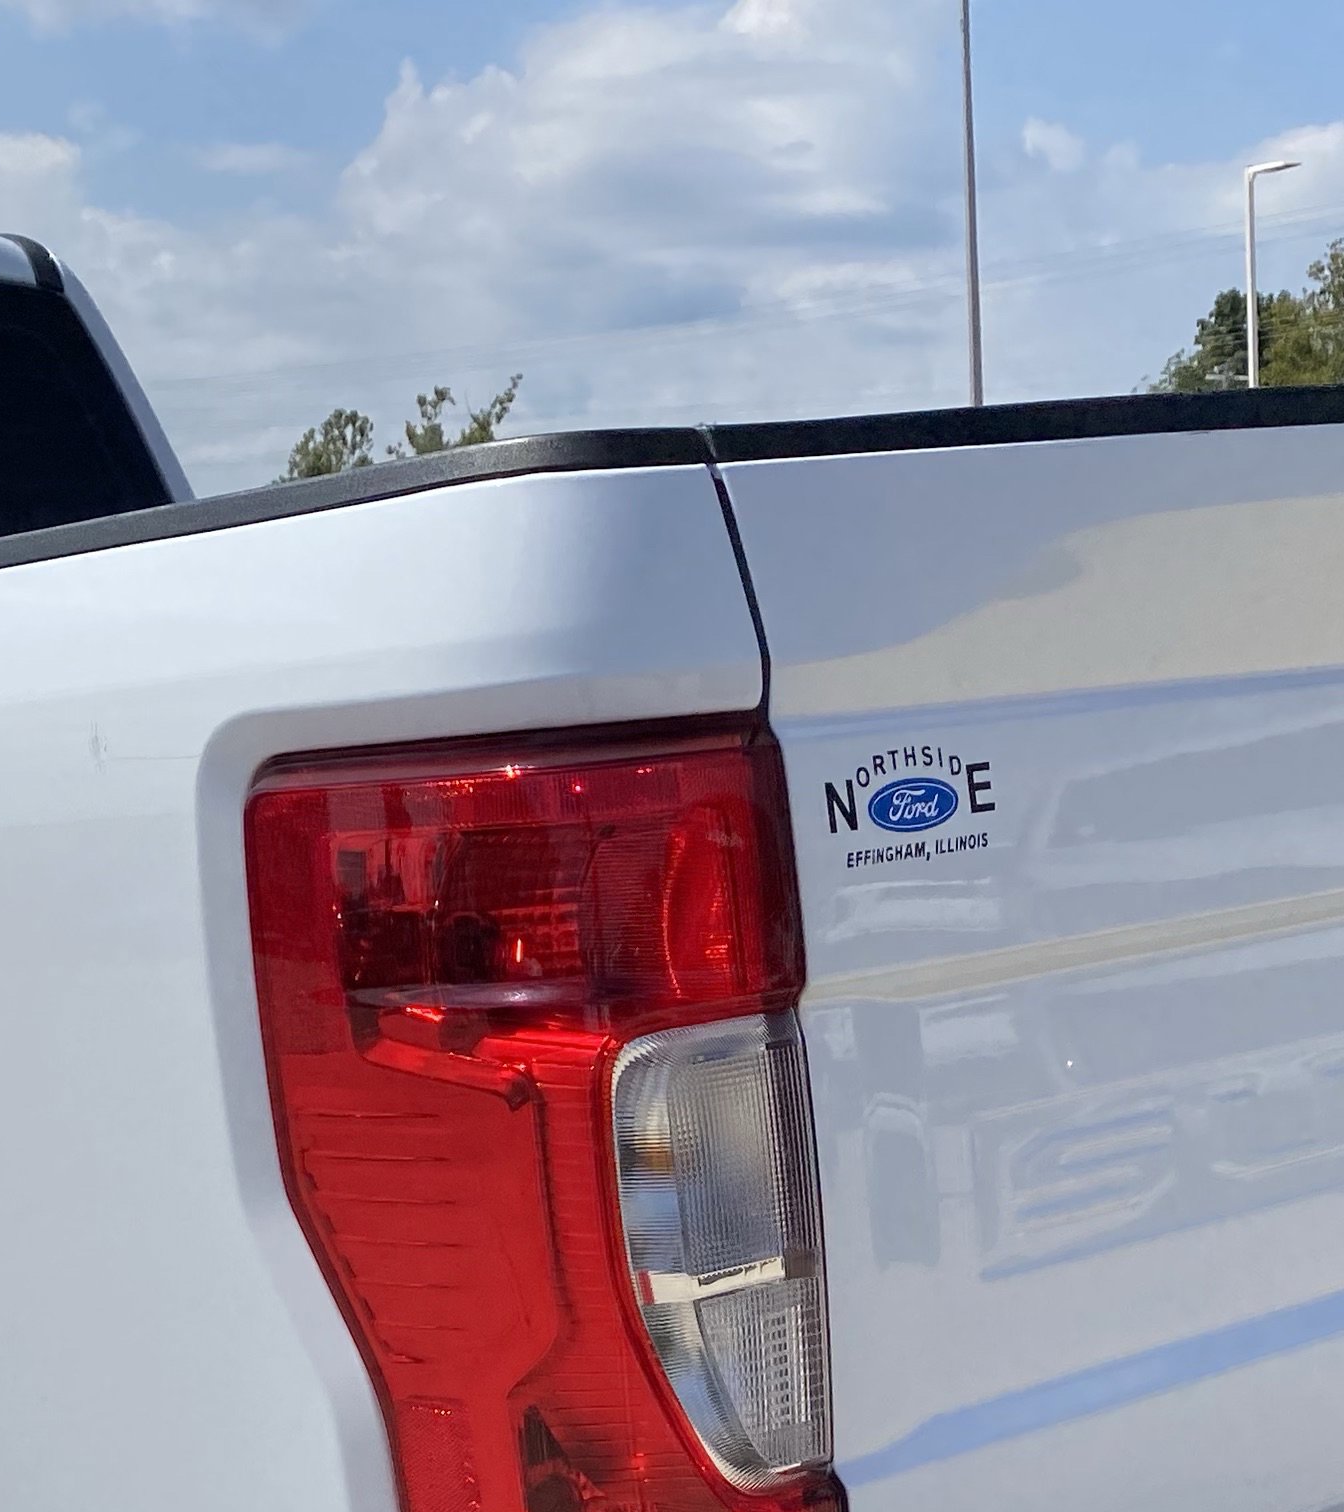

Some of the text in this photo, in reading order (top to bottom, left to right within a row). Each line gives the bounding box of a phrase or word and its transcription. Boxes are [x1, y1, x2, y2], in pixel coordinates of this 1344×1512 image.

[824, 746, 995, 834] NORTHSIDE
[888, 789, 940, 822] Ford
[846, 832, 989, 868] EFFINGHAM, ILLINOIS
